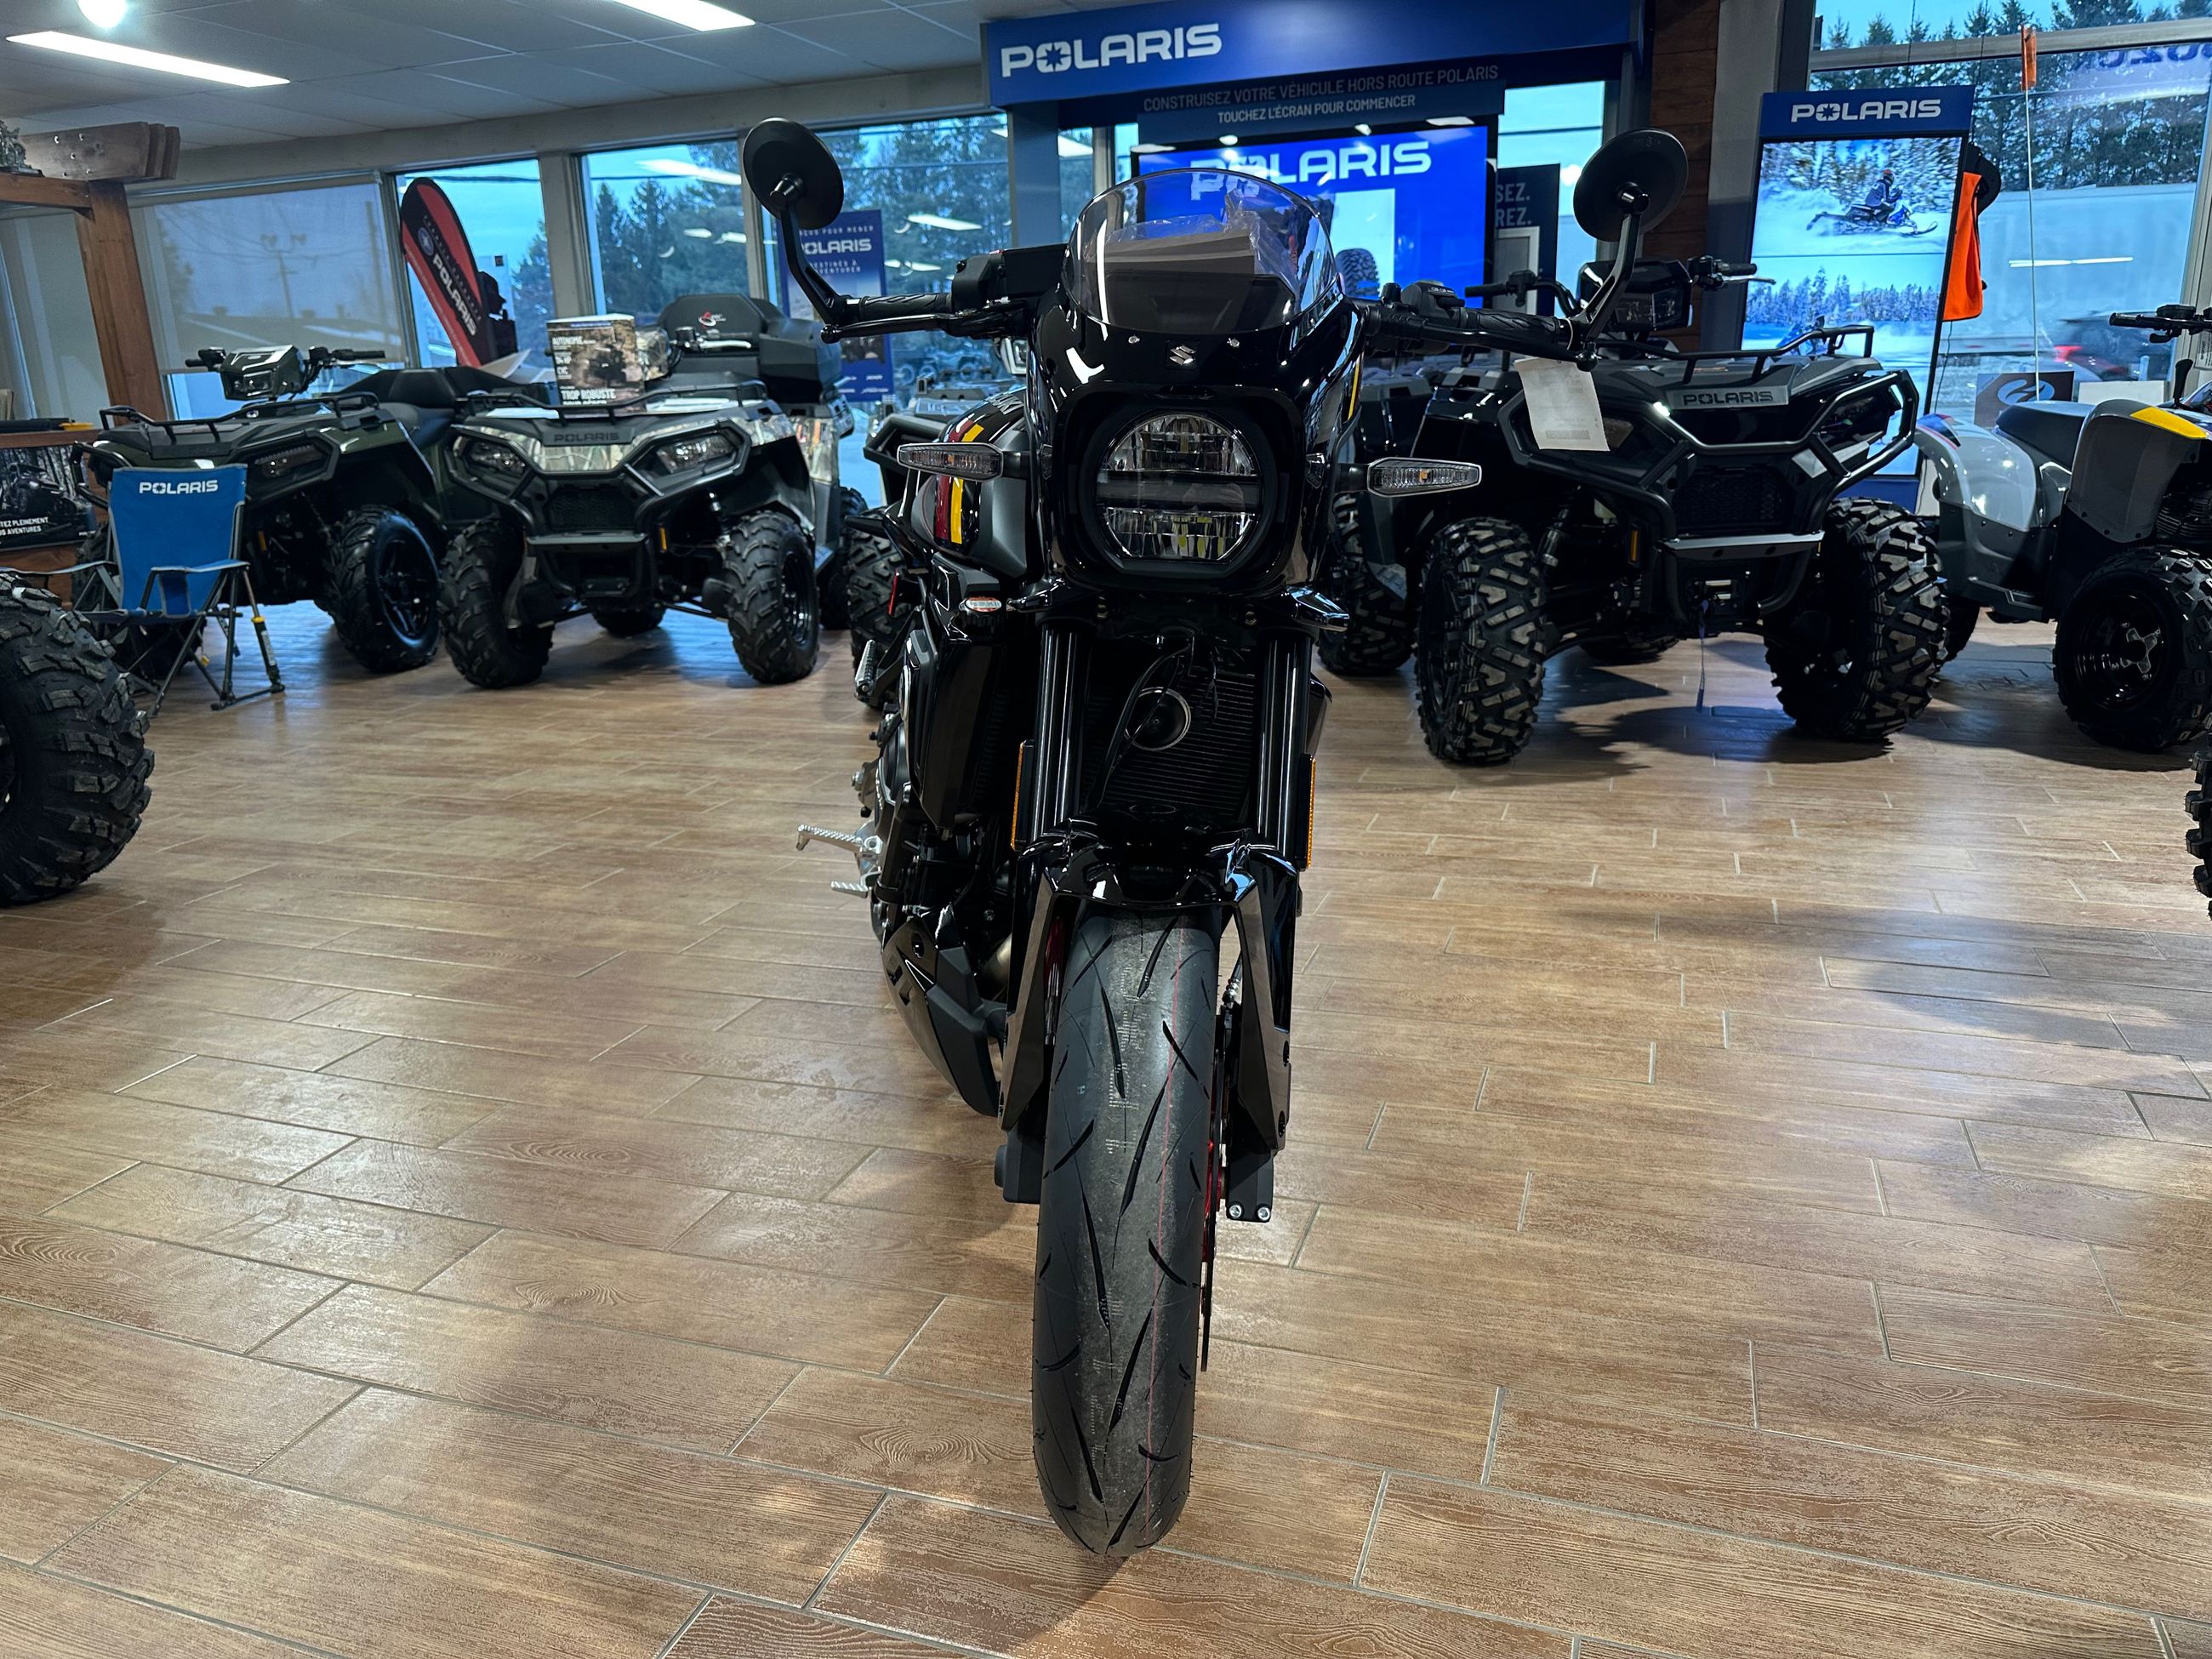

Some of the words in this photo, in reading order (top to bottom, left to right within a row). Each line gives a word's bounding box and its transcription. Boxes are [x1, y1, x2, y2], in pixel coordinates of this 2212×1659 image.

[1001, 23, 1223, 77] POLARIS
[1143, 90, 1231, 111] CONSTRUISEZ
[1234, 86, 1276, 103] VOTRE
[1279, 79, 1345, 99] VÉHICULE
[1348, 75, 1384, 93] HORS
[1388, 71, 1434, 88] ROUTE
[1437, 66, 1498, 84] POLARIS
[1217, 108, 1267, 123] TOUCHEZ
[1268, 104, 1312, 119] L'ÉCRAN
[1314, 101, 1344, 114] POUR
[1346, 94, 1416, 113] COMMENCER
[1791, 99, 1941, 123] POLARIS
[1190, 140, 1432, 201] POLARIS
[802, 238, 873, 254] OLARIS
[432, 254, 477, 336] POLARIS
[1683, 391, 1773, 406] POLARIS
[554, 432, 620, 443] POLARIS
[140, 480, 219, 493] POLARIS
[8, 526, 42, 535] AVENTURES
